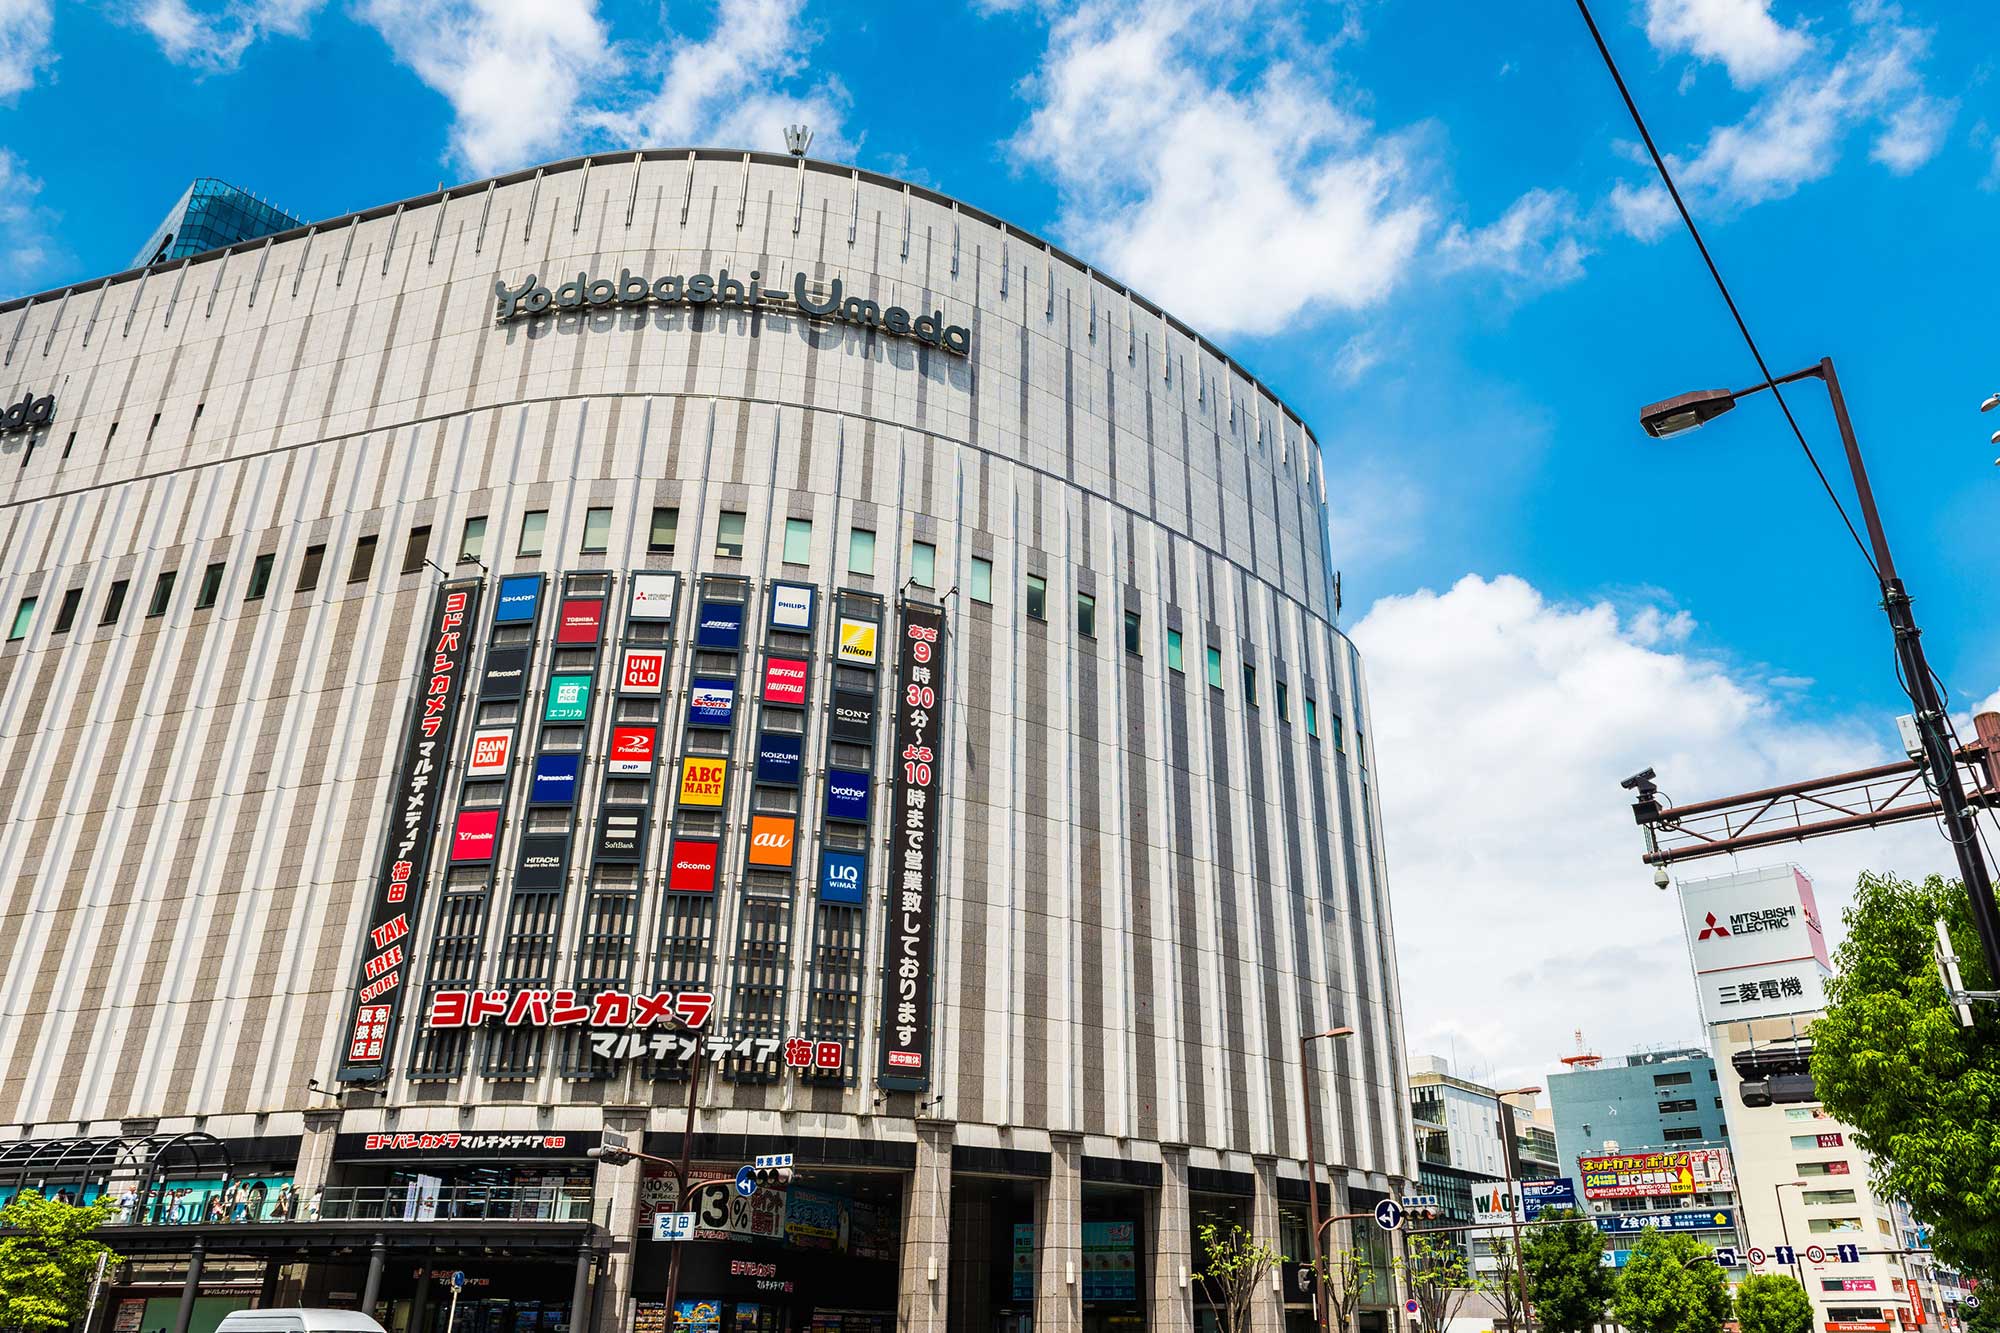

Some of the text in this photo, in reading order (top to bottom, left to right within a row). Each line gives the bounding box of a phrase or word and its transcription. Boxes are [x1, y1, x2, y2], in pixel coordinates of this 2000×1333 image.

[496, 268, 971, 356] Yodobashi-Umeda
[0, 393, 55, 428] da
[501, 594, 536, 602] SHARP
[777, 602, 807, 611] PHILIPS
[701, 620, 740, 629] BOSE
[842, 644, 873, 657] Nikon
[630, 658, 656, 671] UNI
[487, 668, 522, 678] Microsoft
[628, 669, 656, 683] QLO
[768, 667, 804, 678] BUFFALO
[692, 698, 728, 708] SPORTS
[549, 708, 582, 717] エコリカ
[836, 707, 871, 719] SONY
[477, 739, 506, 752] BAN
[475, 751, 499, 764] DAI
[761, 751, 799, 761] KOIZUMI
[685, 766, 722, 783] ABC
[684, 782, 721, 794] MART
[831, 785, 867, 798] brother
[604, 841, 635, 849] SoftBank
[754, 831, 790, 848] au
[677, 860, 711, 871] docomo
[830, 864, 858, 883] UQ
[829, 880, 857, 890] WiMAX
[1729, 906, 1796, 925] MITSUBISHI
[371, 912, 409, 950] TAX
[1732, 917, 1789, 935] ELECTRIC
[365, 944, 403, 982] FREE
[359, 970, 399, 1003] STORE
[1718, 976, 1803, 1005] 三菱電機
[430, 989, 715, 1028] ヨドバシカメラ
[590, 1032, 843, 1069] マルチメディア梅田
[1583, 1157, 1643, 1172] ネットカフェ
[1646, 1154, 1689, 1169] ポパイ
[1586, 1175, 1600, 1187] 24
[660, 1216, 689, 1229] 芝田
[1620, 1215, 1673, 1228] Z会の教室
[1810, 1250, 1821, 1259] 40
[731, 1260, 777, 1278] ヨドバシカメラ
